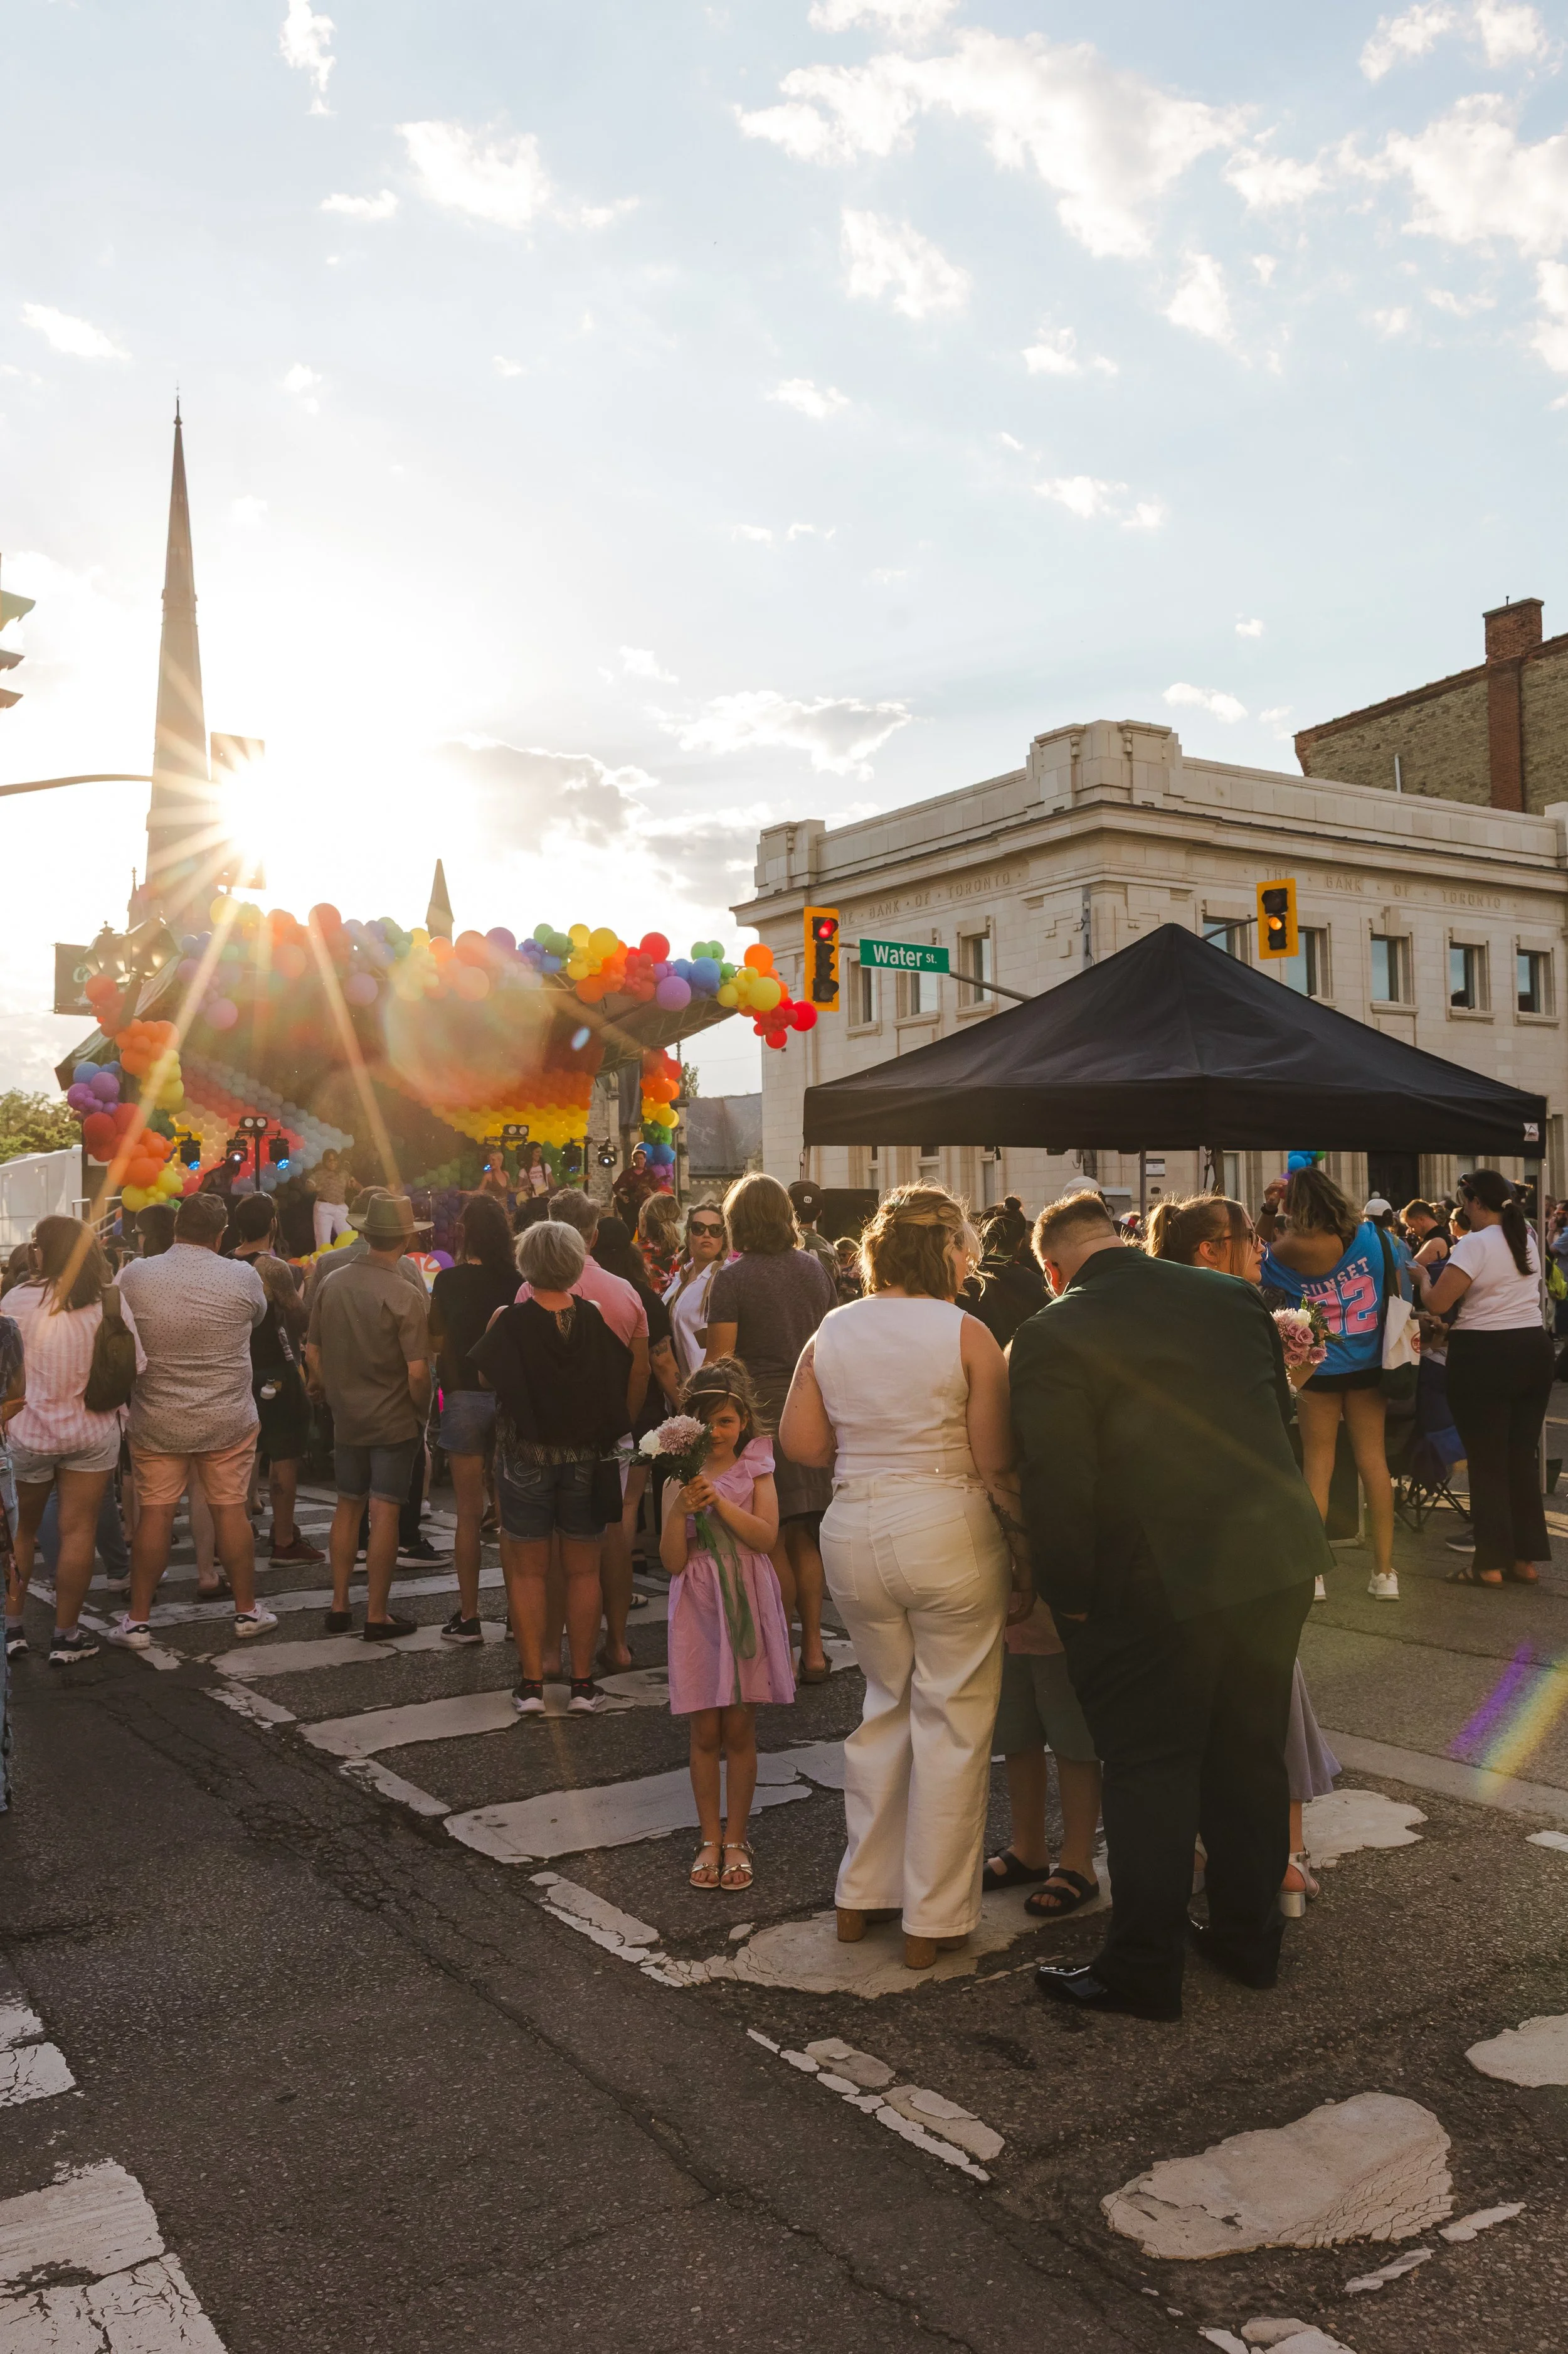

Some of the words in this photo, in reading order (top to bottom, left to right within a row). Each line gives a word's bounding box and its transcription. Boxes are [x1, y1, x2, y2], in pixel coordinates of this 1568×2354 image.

[839, 911, 854, 927] HE
[869, 900, 900, 919] BANK
[914, 893, 930, 907] OF
[947, 873, 1010, 898] TORONTO
[1325, 875, 1363, 892] BANK
[1393, 883, 1411, 897] OF
[1441, 890, 1502, 909] TORONTO
[873, 944, 923, 967] Water
[926, 953, 937, 964] St.
